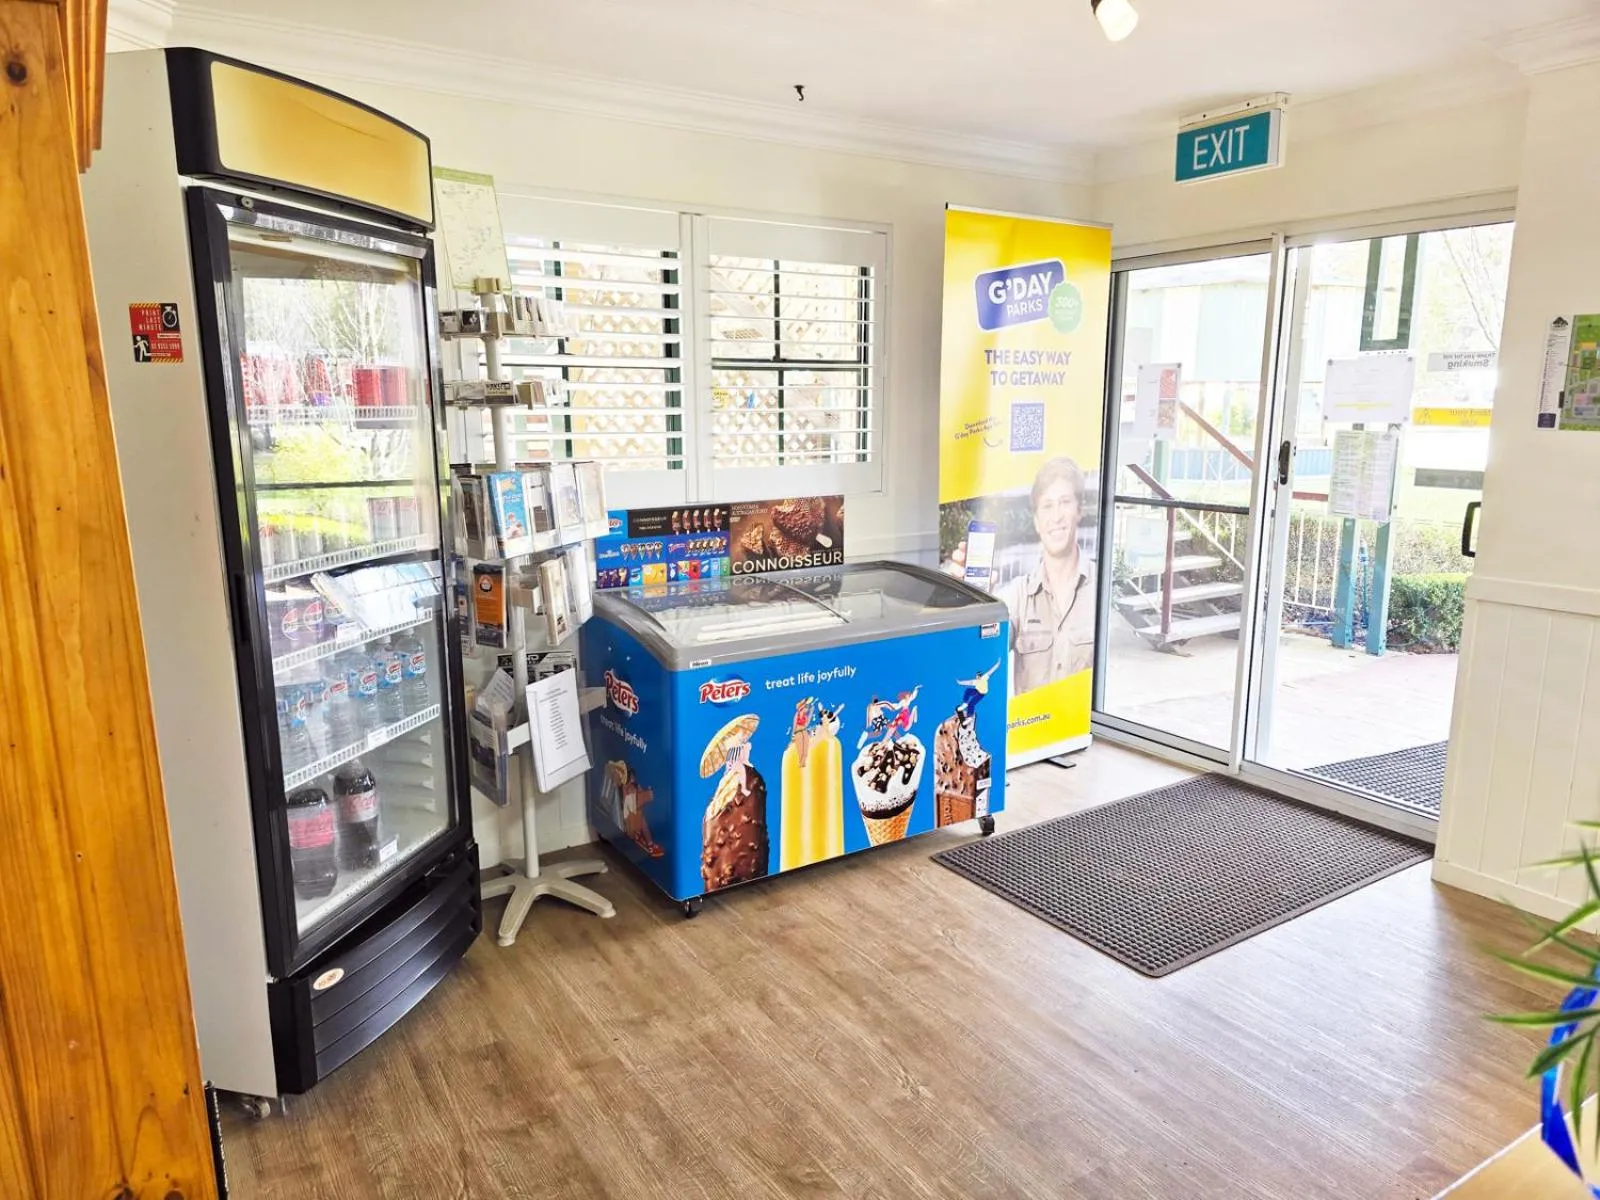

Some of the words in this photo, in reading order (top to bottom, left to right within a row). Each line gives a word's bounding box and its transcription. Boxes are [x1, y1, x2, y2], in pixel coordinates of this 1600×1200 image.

[1193, 124, 1250, 170] EXIT
[988, 271, 1053, 305] G'DAY
[1007, 298, 1043, 318] PARKS
[984, 349, 1011, 365] THE
[1013, 350, 1044, 366] EASY
[1044, 351, 1071, 366] WAY
[990, 370, 1008, 386] TO
[1010, 371, 1066, 386] GETAWAY
[731, 550, 843, 575] CONNOISSEUR
[765, 676, 795, 690] treat
[797, 672, 815, 685] life
[817, 665, 857, 684] joyfully
[604, 670, 639, 713] Peters
[699, 679, 751, 704] Peters
